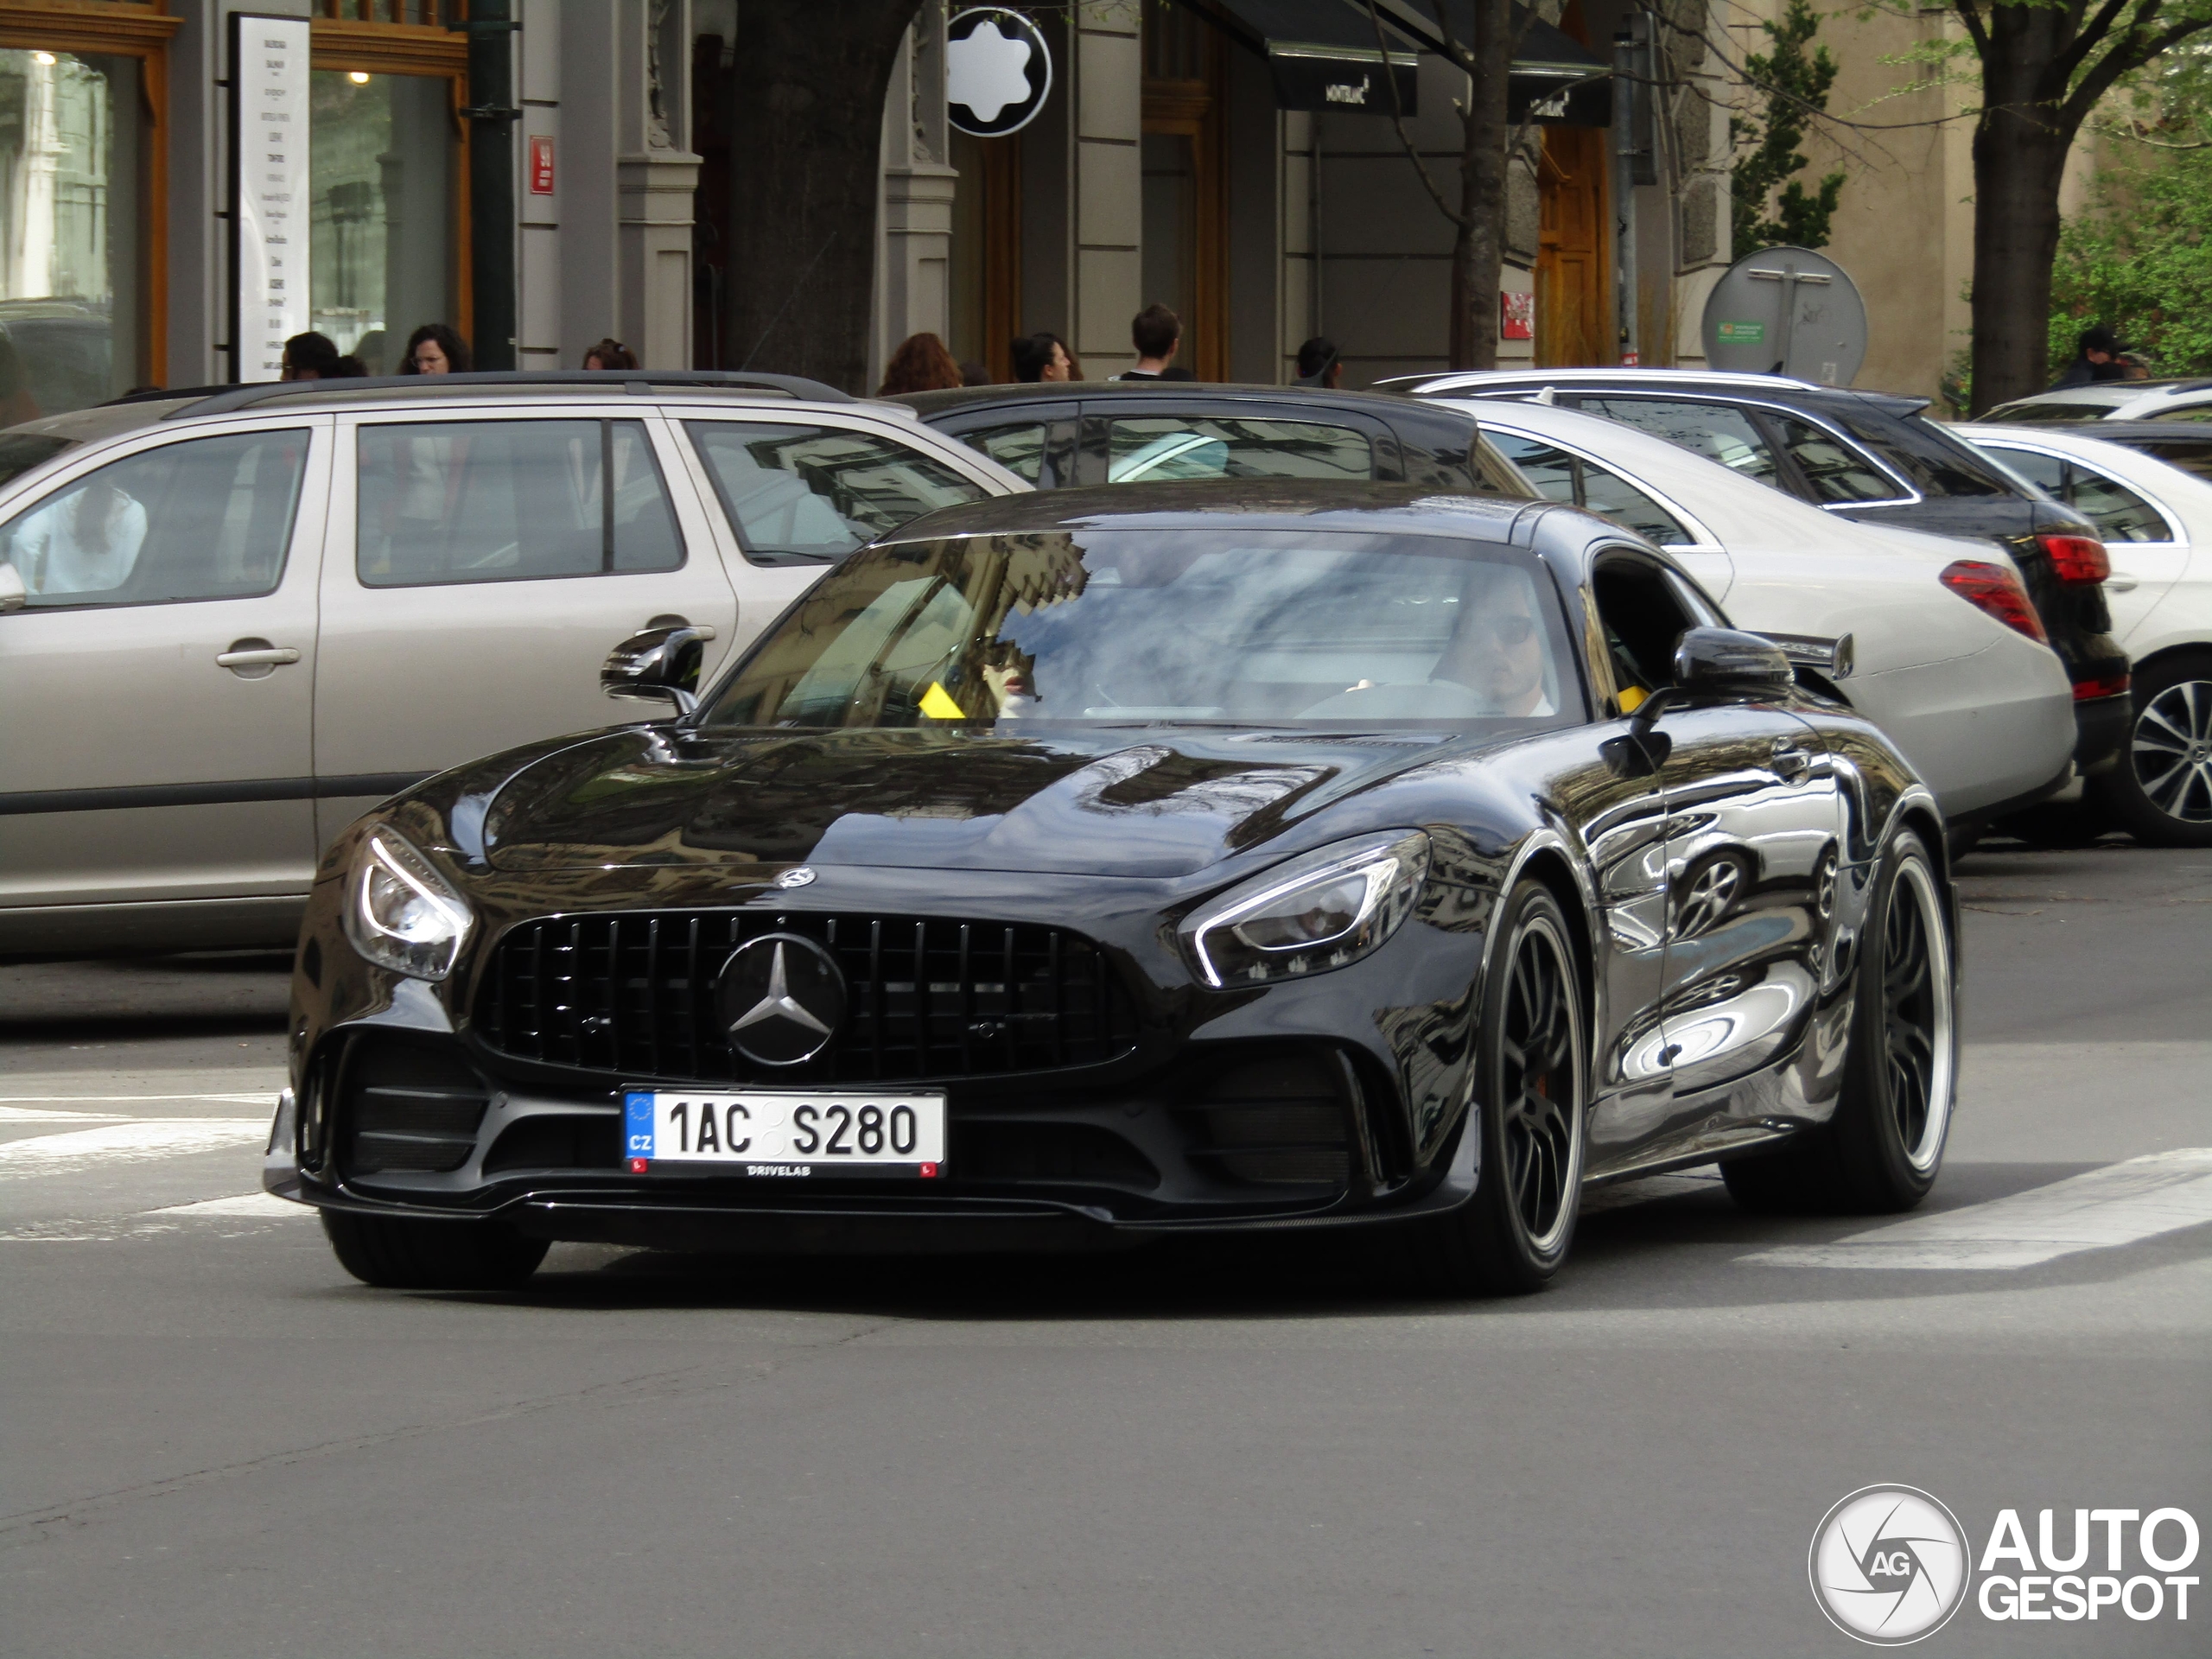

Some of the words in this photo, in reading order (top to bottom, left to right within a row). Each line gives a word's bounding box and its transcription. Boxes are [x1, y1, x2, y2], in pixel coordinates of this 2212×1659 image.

[671, 1102, 752, 1154] 1AC
[793, 1104, 916, 1154] S280
[629, 1135, 652, 1151] CZ
[747, 1166, 810, 1177] DRIVELAB
